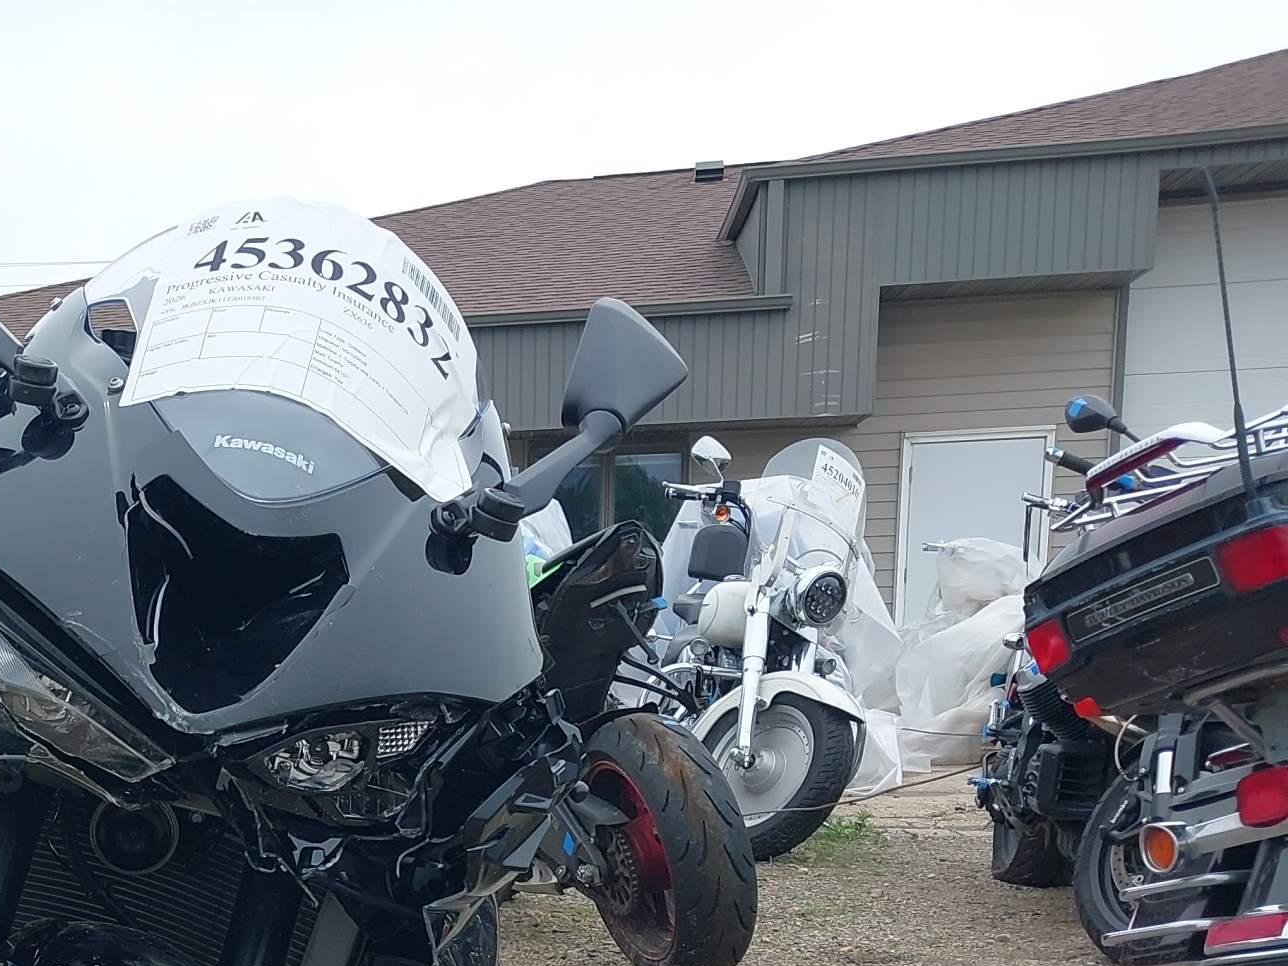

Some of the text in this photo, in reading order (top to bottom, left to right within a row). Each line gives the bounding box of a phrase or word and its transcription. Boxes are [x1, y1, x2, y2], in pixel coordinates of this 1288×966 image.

[166, 271, 395, 333] Progressive Casualty Insurance
[194, 237, 452, 380] 45362832
[209, 285, 275, 295] KAWASAKI
[214, 435, 315, 474] Kawasaki
